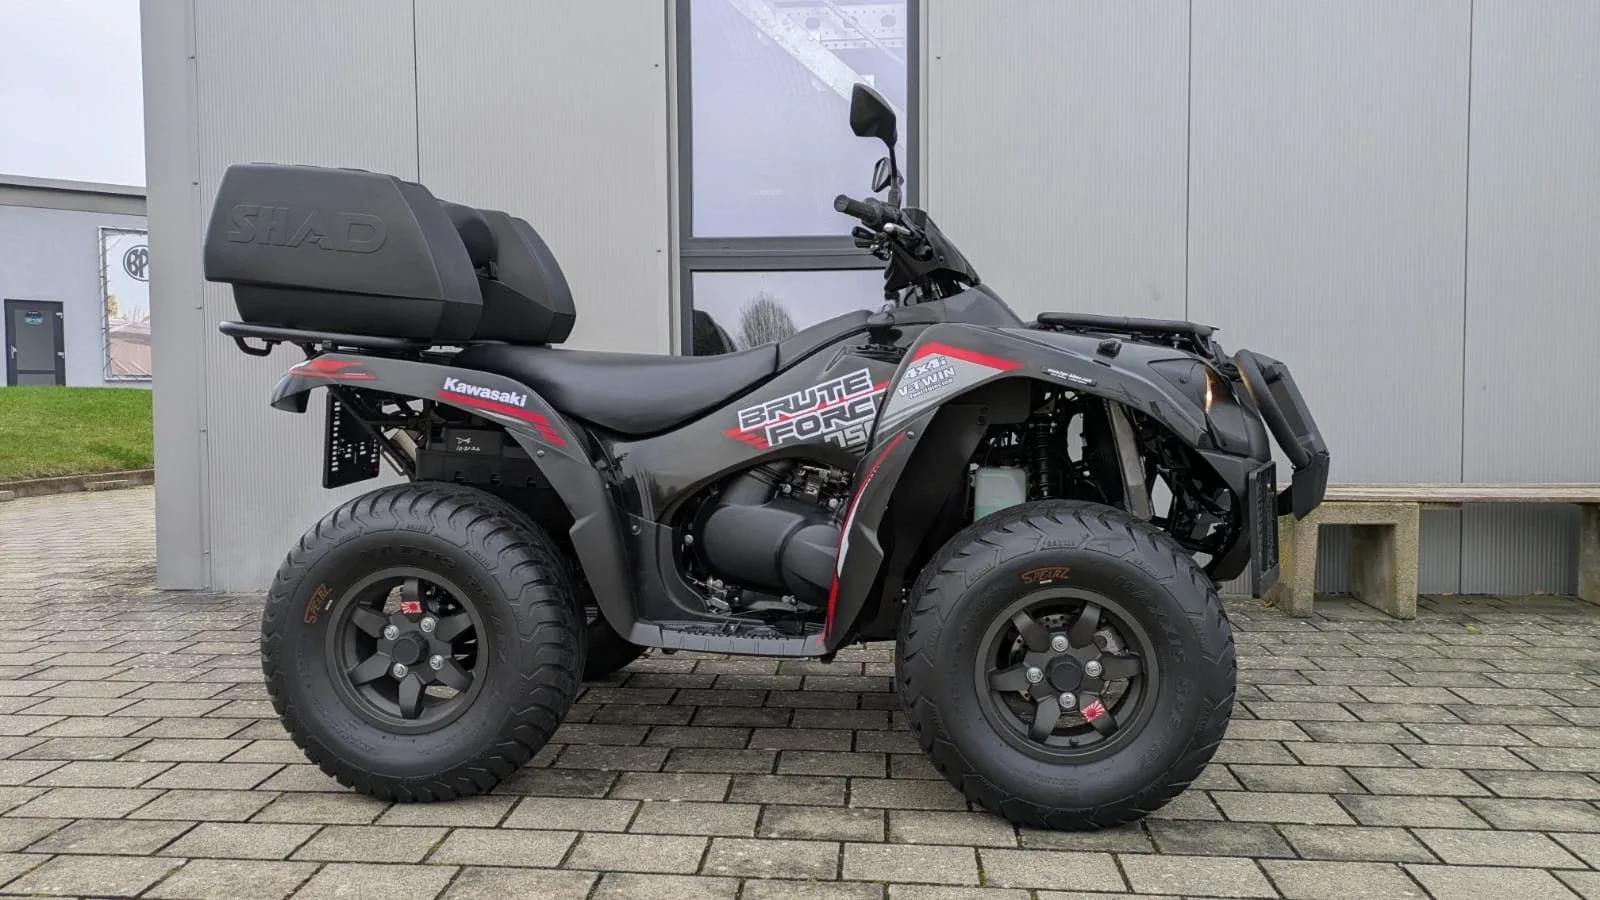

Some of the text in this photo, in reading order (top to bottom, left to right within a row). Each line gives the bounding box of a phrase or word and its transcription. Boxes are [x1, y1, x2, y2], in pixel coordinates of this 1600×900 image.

[226, 203, 388, 254] SHAD
[443, 377, 527, 407] Kawasaki
[737, 367, 874, 432] BRUTE
[898, 366, 956, 397] V-TWIN
